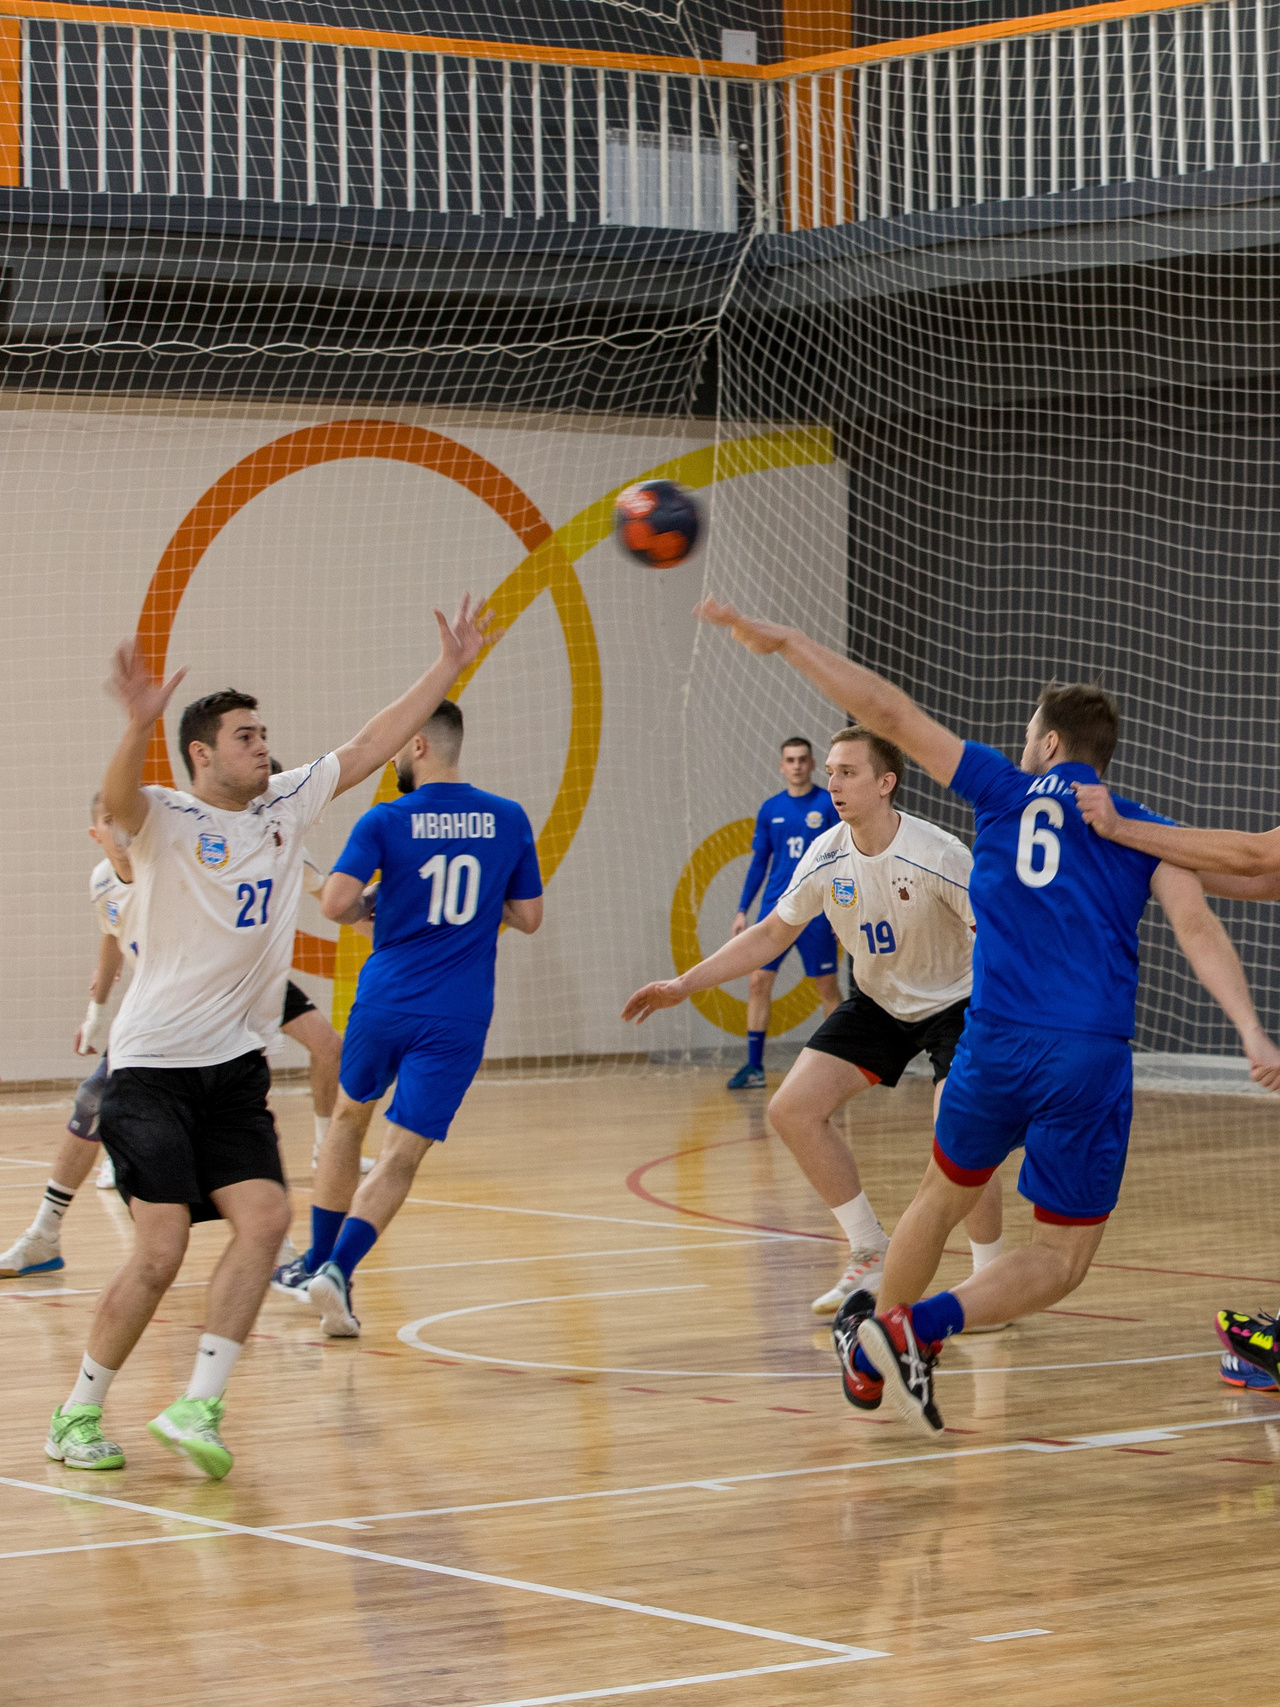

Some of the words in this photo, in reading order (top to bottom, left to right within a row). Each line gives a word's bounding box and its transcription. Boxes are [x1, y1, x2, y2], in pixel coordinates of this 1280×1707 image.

[411, 812, 496, 839] ИВАНОВ
[1016, 796, 1064, 888] 6
[786, 836, 804, 859] 13
[235, 878, 273, 928] 27
[418, 854, 482, 926] 10
[860, 920, 896, 954] 19
